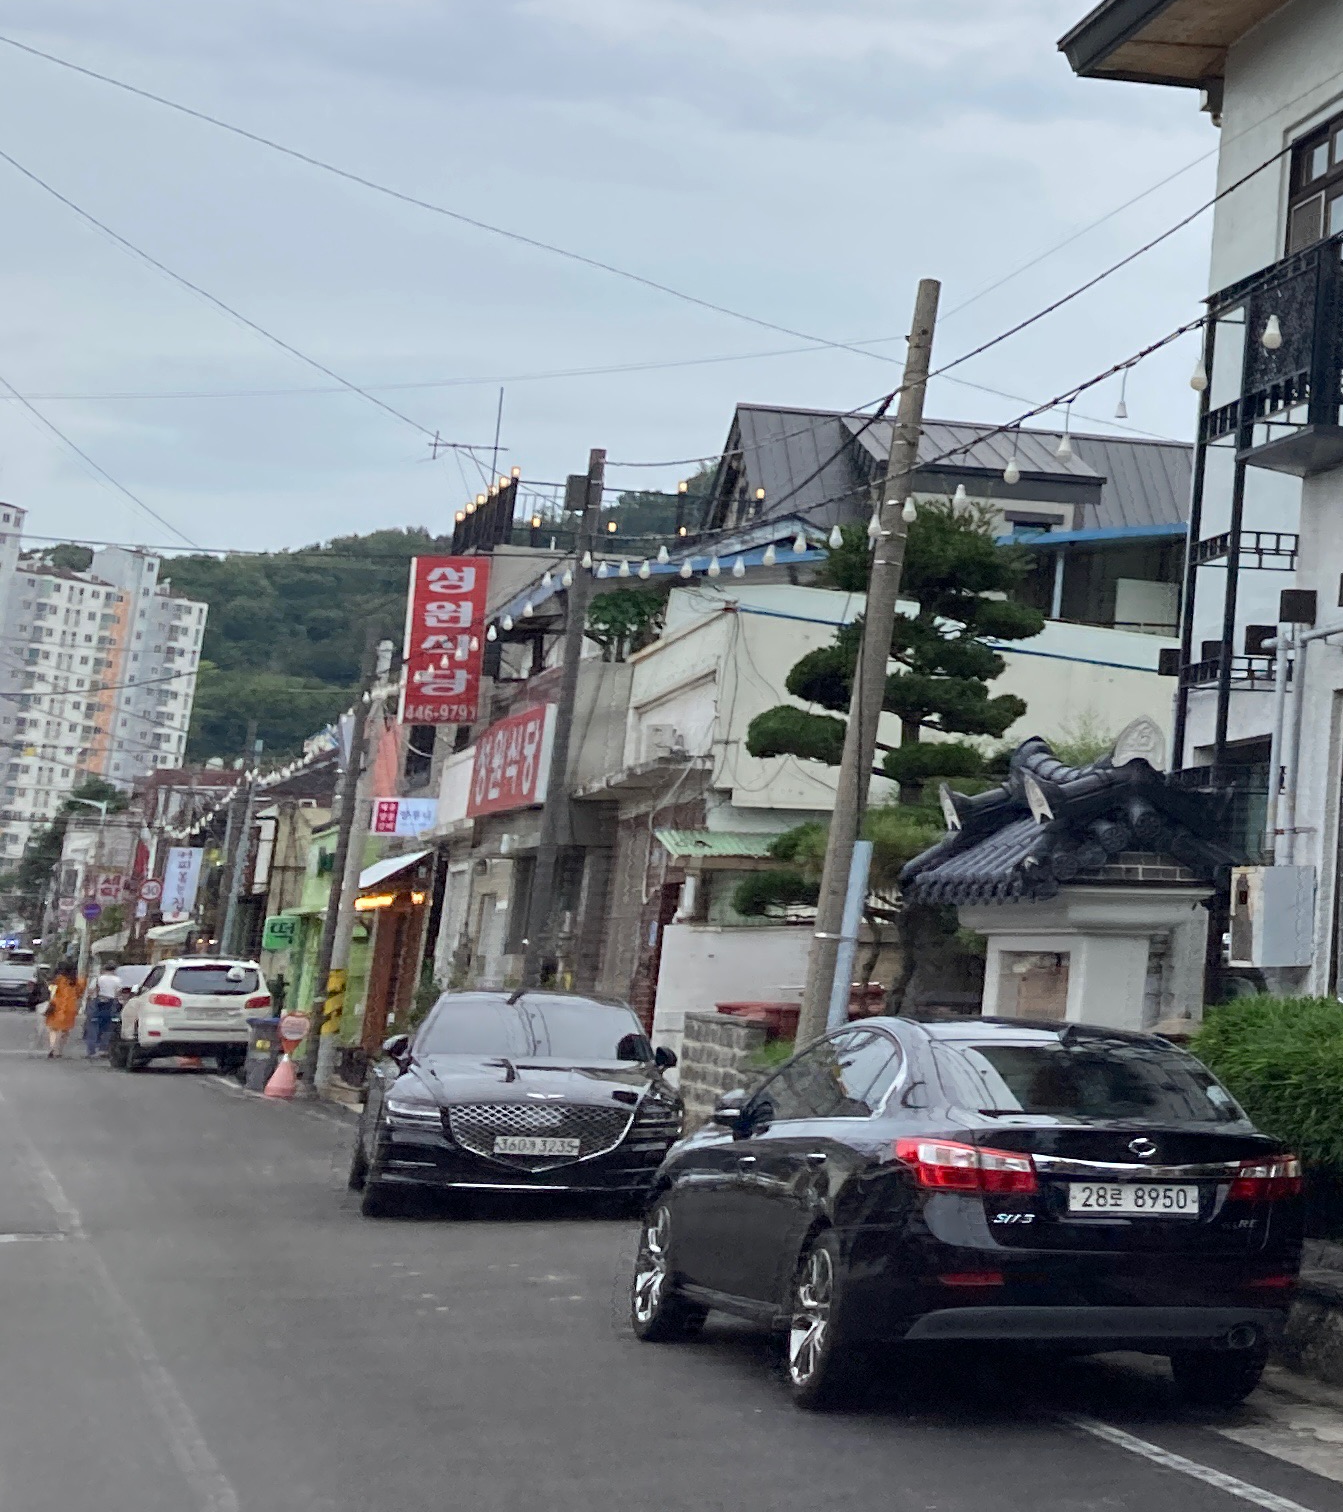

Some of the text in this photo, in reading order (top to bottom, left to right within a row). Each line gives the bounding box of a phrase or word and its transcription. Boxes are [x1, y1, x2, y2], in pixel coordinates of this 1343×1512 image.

[420, 566, 476, 697] 성원식당
[474, 719, 542, 806] 성원식당
[1081, 1186, 1188, 1209] 28로 8950
